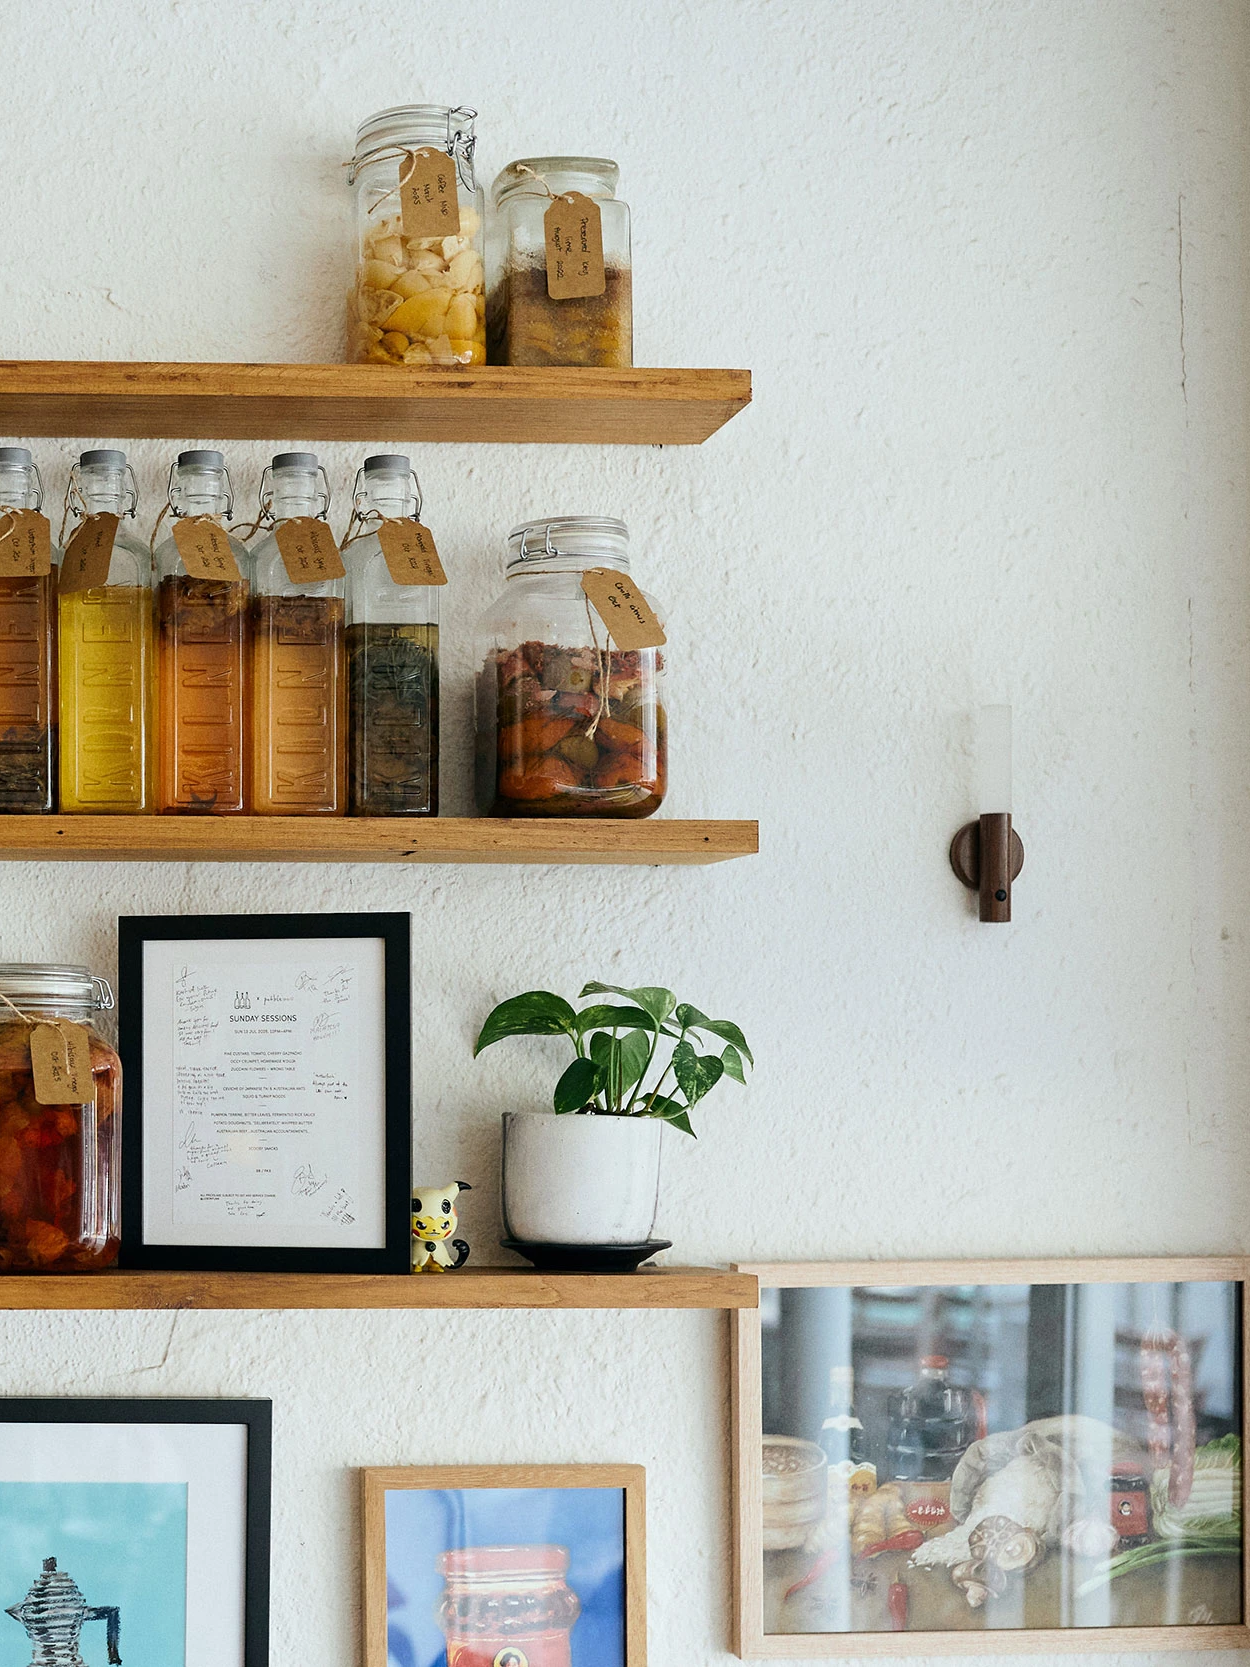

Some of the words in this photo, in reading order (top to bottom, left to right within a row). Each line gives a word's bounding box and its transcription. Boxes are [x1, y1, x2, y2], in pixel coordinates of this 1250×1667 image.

[436, 173, 447, 194] Coffee
[440, 199, 450, 216] Miso
[552, 226, 562, 253] August
[230, 1014, 259, 1022] SUNDAY
[261, 1014, 297, 1022] SESSIONS
